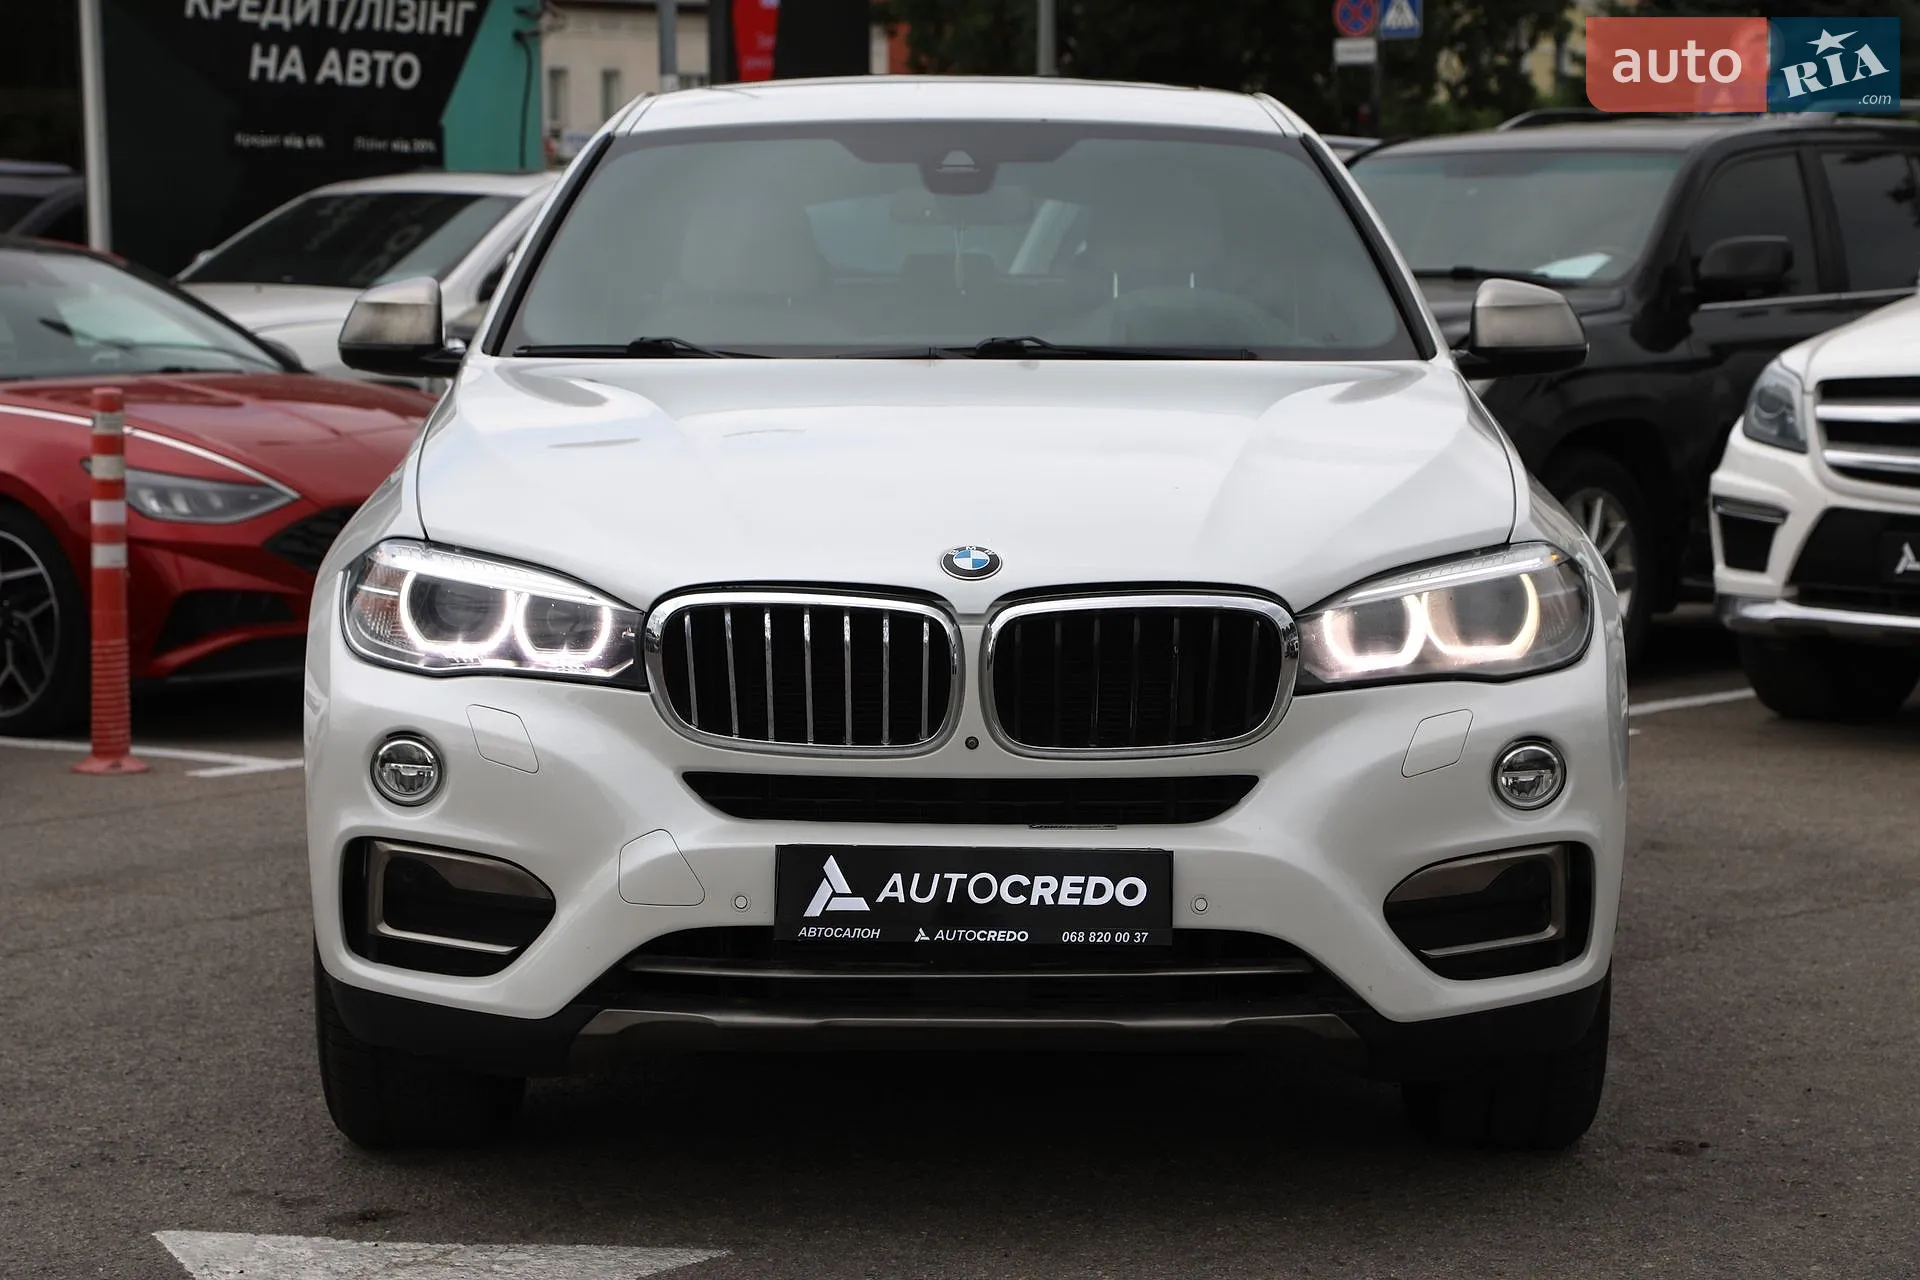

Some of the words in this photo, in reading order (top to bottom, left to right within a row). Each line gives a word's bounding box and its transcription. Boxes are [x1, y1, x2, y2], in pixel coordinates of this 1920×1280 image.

[249, 43, 306, 83] НА
[315, 47, 421, 89] АВТО
[875, 872, 1148, 907] AUTOCREDO
[798, 926, 881, 939] АВТОСАЛОН
[934, 929, 1029, 942] AUTOCREDO
[1061, 931, 1085, 943] 068
[1088, 931, 1111, 943] 820
[1114, 932, 1131, 943] 00
[1133, 932, 1149, 944] 37
